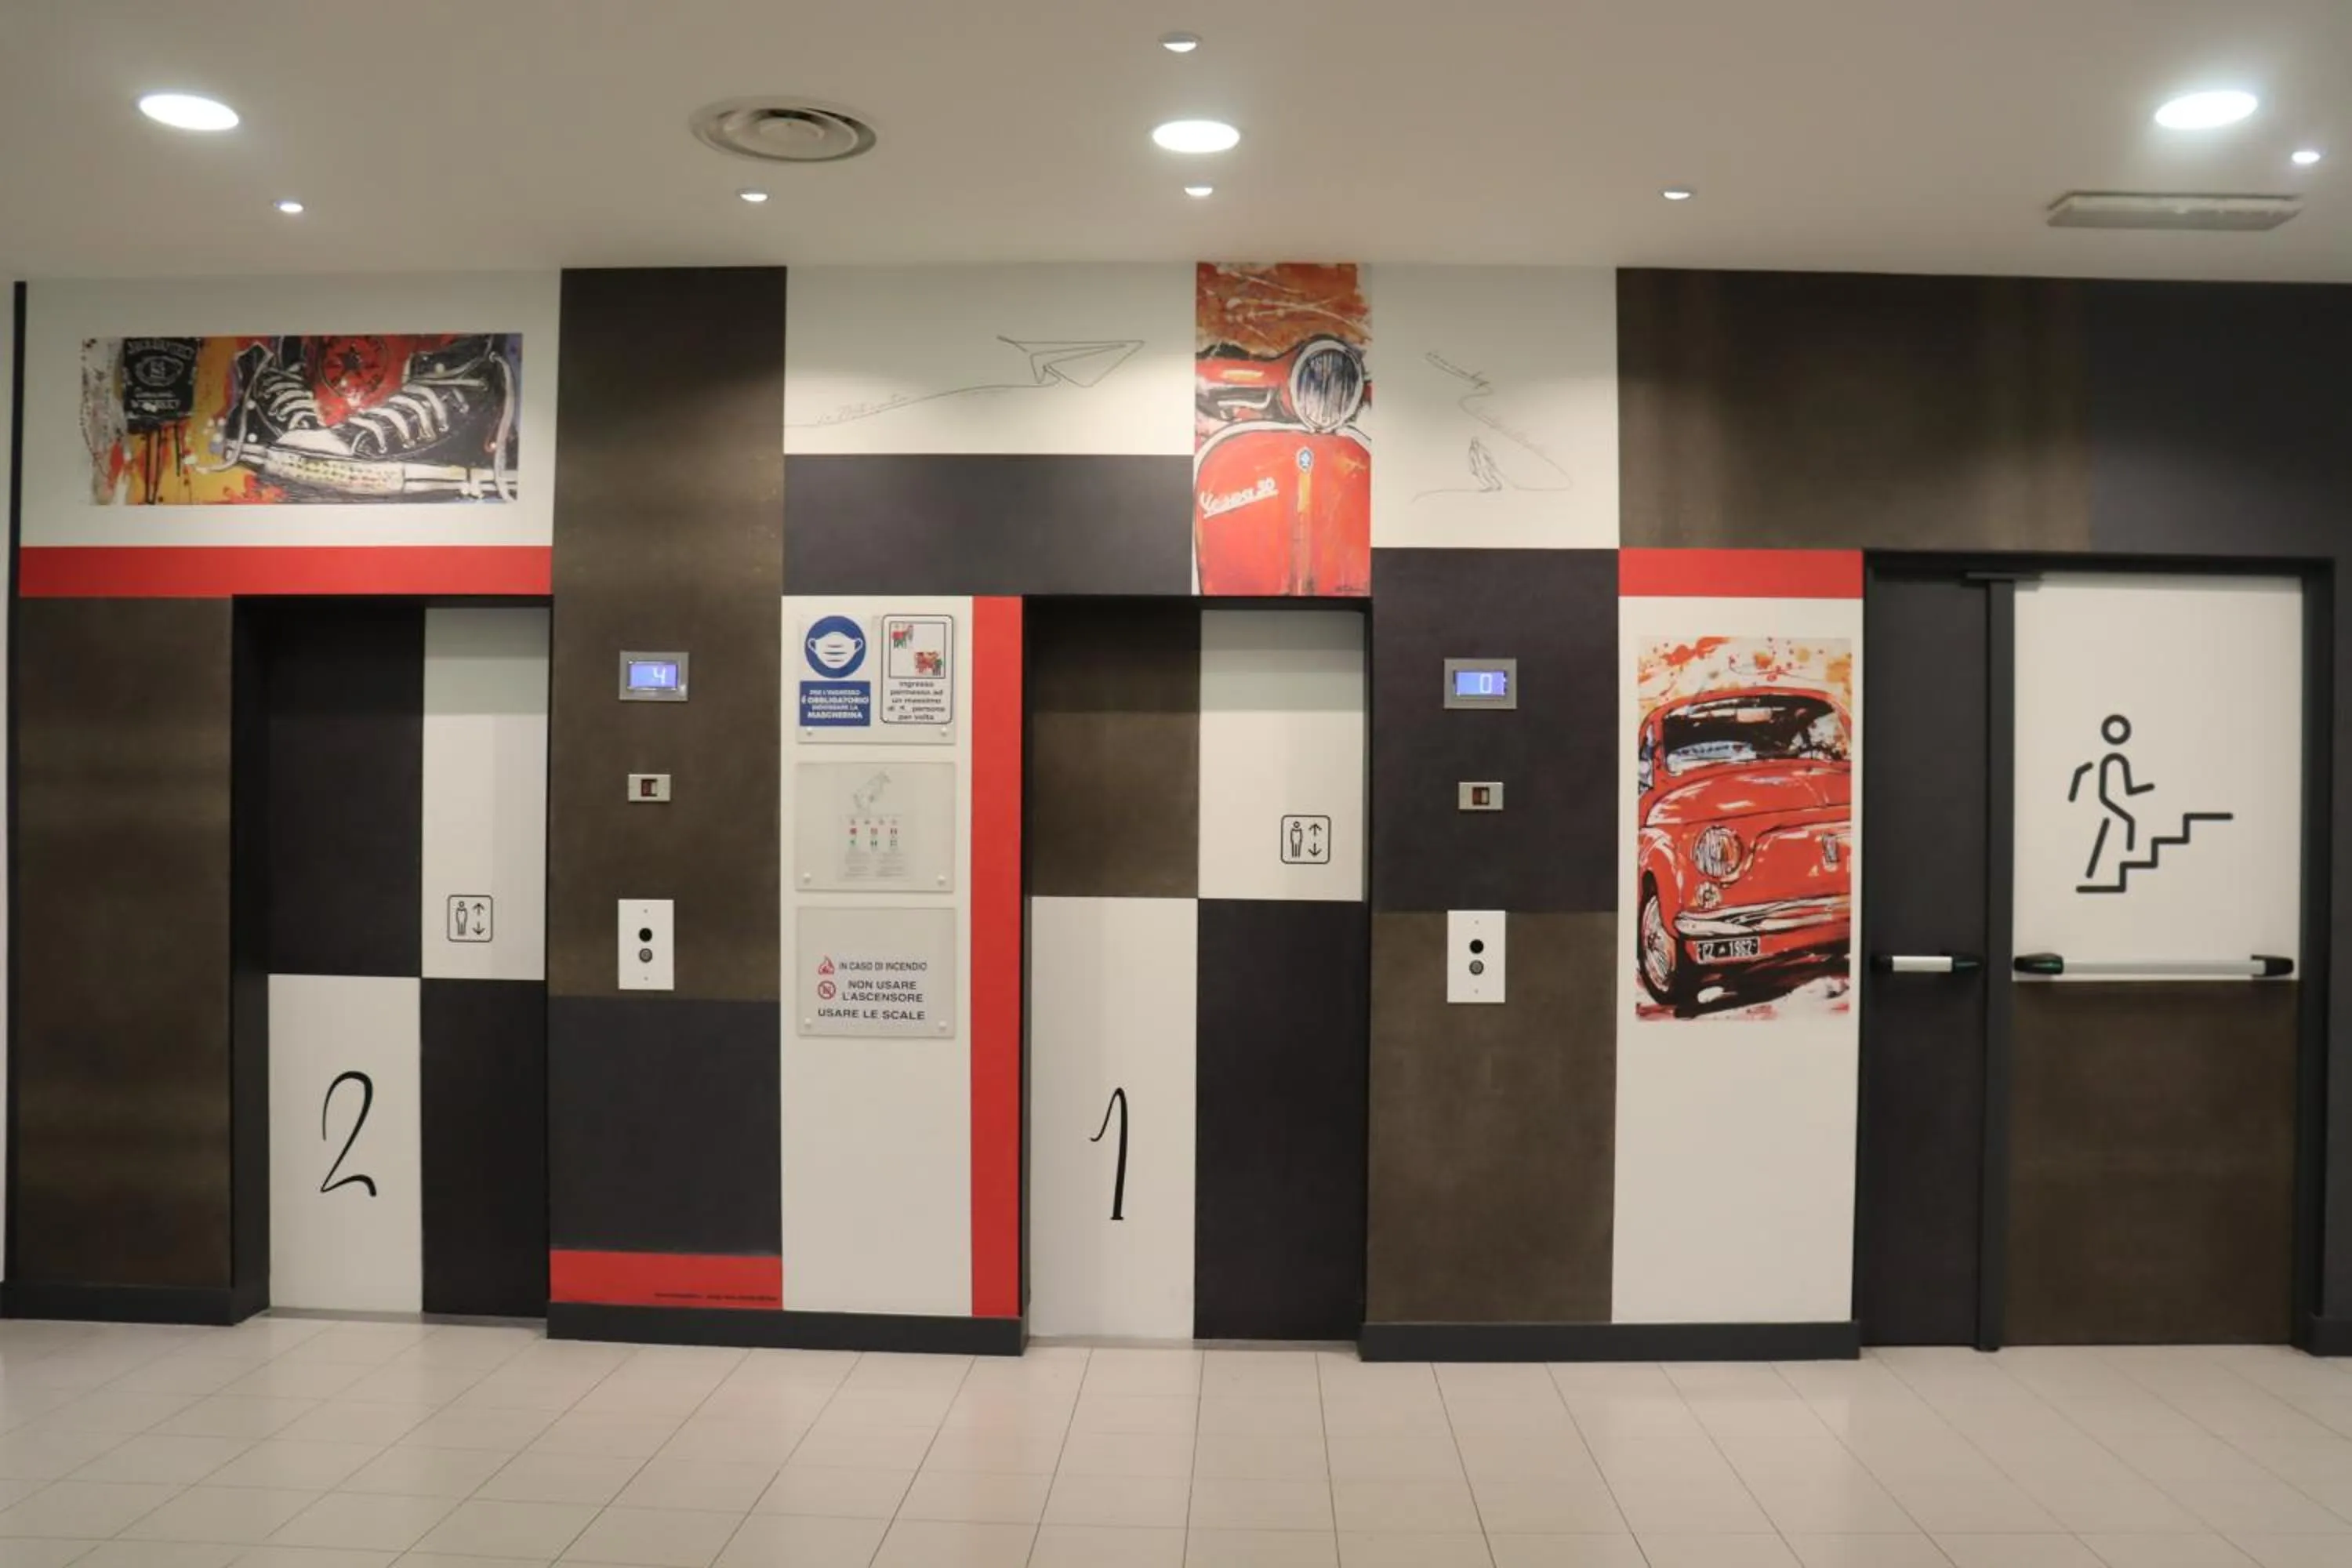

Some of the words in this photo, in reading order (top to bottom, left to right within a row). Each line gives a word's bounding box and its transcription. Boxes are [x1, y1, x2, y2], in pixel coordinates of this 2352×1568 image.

[652, 666, 666, 684] 4
[1479, 673, 1492, 694] 0
[849, 962, 873, 971] CASO
[874, 962, 884, 971] DI
[885, 962, 927, 971] INCENDIO
[848, 980, 873, 989] NON
[876, 981, 916, 990] USARE
[842, 992, 924, 1003] L'ASCENSORE
[818, 1007, 859, 1018] USARE
[863, 1009, 878, 1019] LE
[882, 1010, 926, 1020] SCALE
[320, 1070, 376, 1197] 2
[1090, 1087, 1128, 1221] 1
